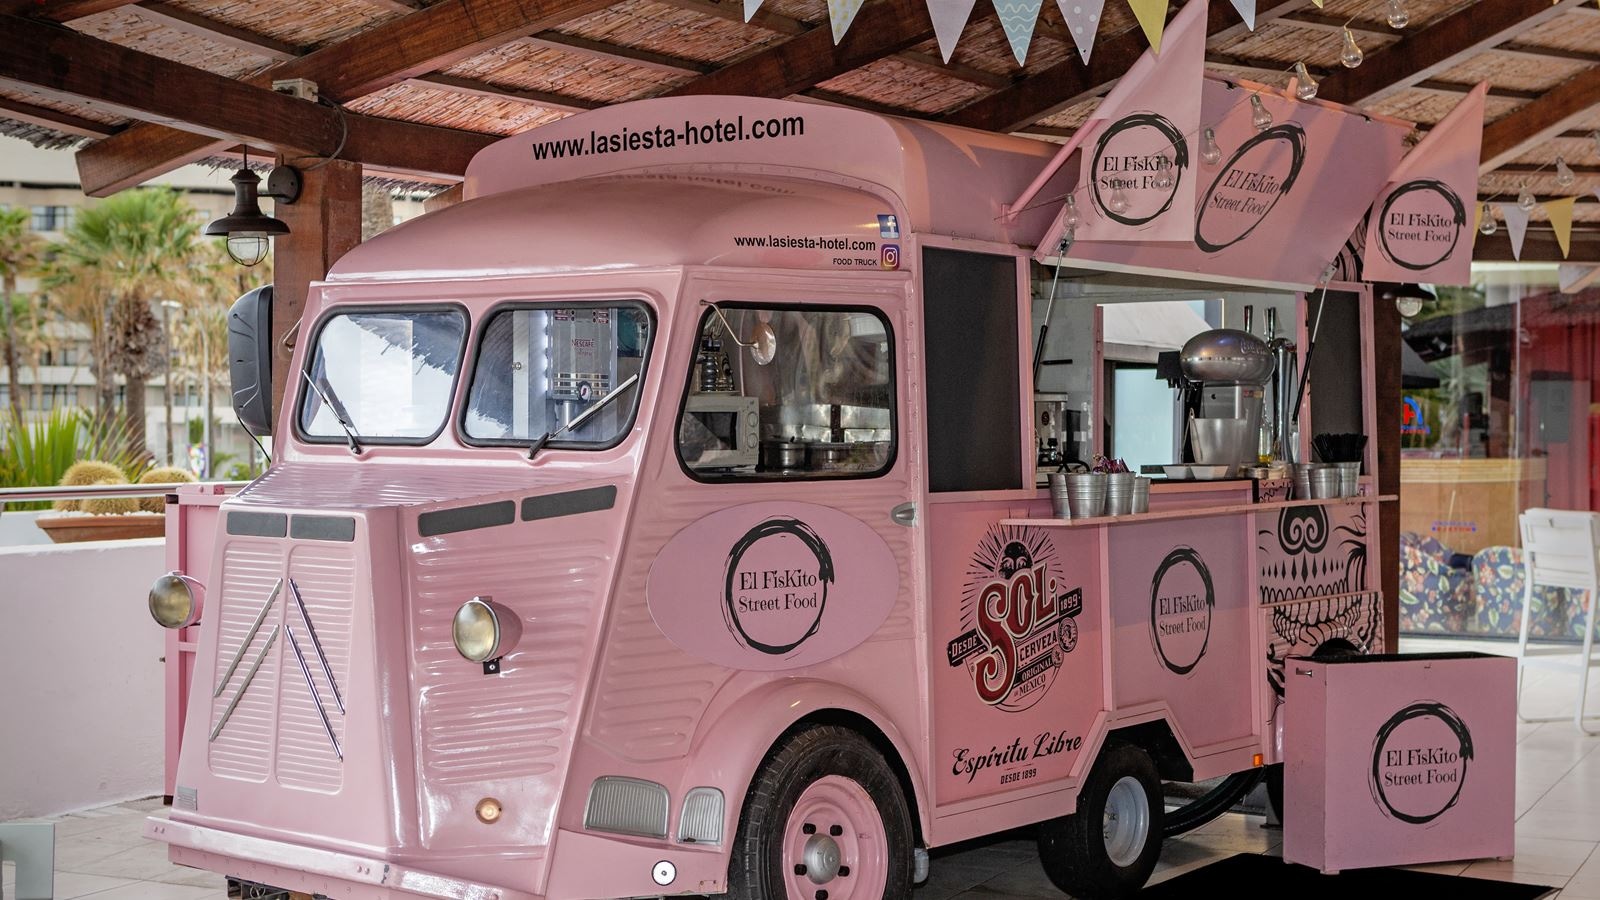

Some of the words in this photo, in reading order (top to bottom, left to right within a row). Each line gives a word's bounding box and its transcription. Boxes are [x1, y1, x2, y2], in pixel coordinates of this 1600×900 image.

[532, 115, 805, 161] www.lasiesta-hotel.com
[1103, 156, 1119, 172] El
[1223, 169, 1243, 189] El
[1239, 172, 1280, 195] FisKito
[1209, 191, 1241, 211] Street
[1240, 197, 1269, 215] Food
[1390, 213, 1404, 226] El
[1408, 213, 1452, 227] FisKito
[734, 235, 876, 251] www.lasiesta-hotel.com
[1388, 228, 1420, 241] Street
[1424, 230, 1451, 242] Food
[832, 257, 853, 266] FOOD
[854, 258, 877, 266] TRUCK
[739, 571, 758, 591] El
[761, 568, 817, 589] FisKito
[738, 595, 780, 613] Street
[784, 592, 817, 610] Food
[1060, 593, 1078, 611] 1899
[1159, 597, 1171, 615] El
[1173, 594, 1206, 613] FisKito
[1159, 620, 1184, 636] Street
[1186, 616, 1206, 632] Food
[951, 633, 978, 658] DESDE
[1019, 630, 1058, 661] CERVEZA
[1021, 655, 1053, 681] ORIGINAL
[952, 737, 1029, 784] Espíritu
[1032, 730, 1082, 760] Libre
[1386, 750, 1403, 767] El
[1406, 747, 1458, 766] FisKito
[1000, 772, 1020, 784] DESDE
[1021, 768, 1037, 780] 1899
[1384, 771, 1423, 787] Street
[1426, 768, 1457, 785] Food
